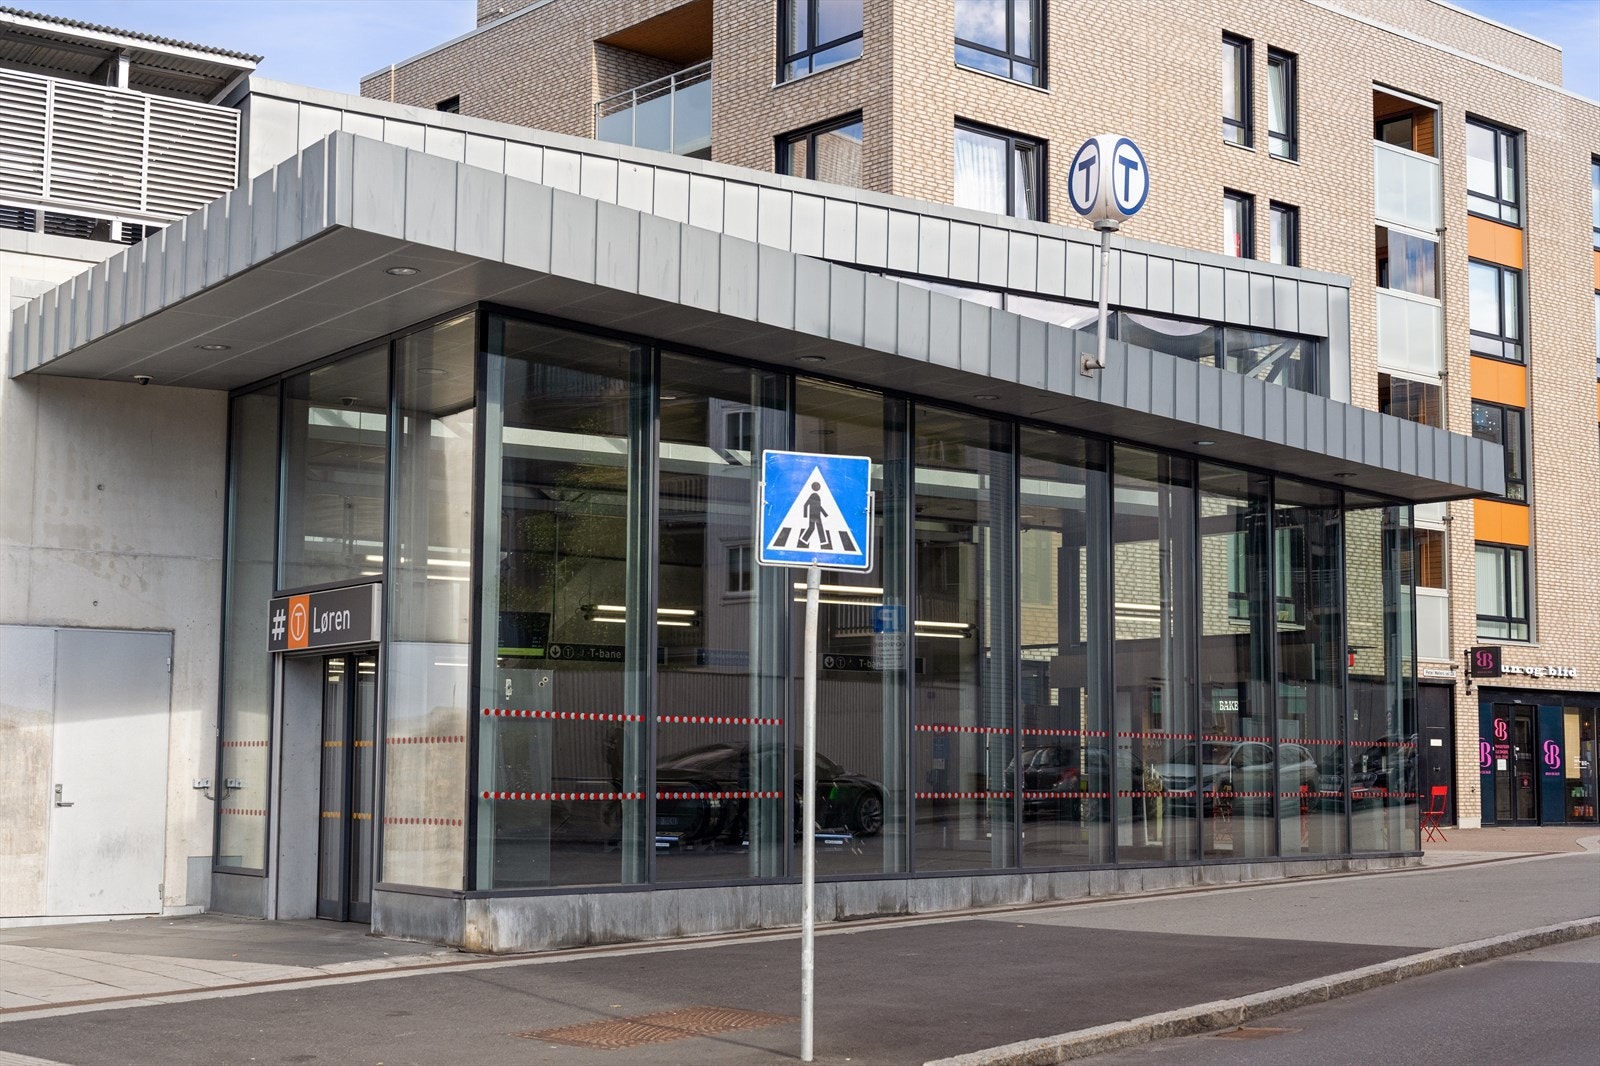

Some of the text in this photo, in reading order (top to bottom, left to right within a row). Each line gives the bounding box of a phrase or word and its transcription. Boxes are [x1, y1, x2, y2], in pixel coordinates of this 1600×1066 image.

[1079, 155, 1096, 202] T
[1119, 155, 1138, 202] T
[313, 607, 350, 633] Løren
[590, 648, 621, 658] T-bane
